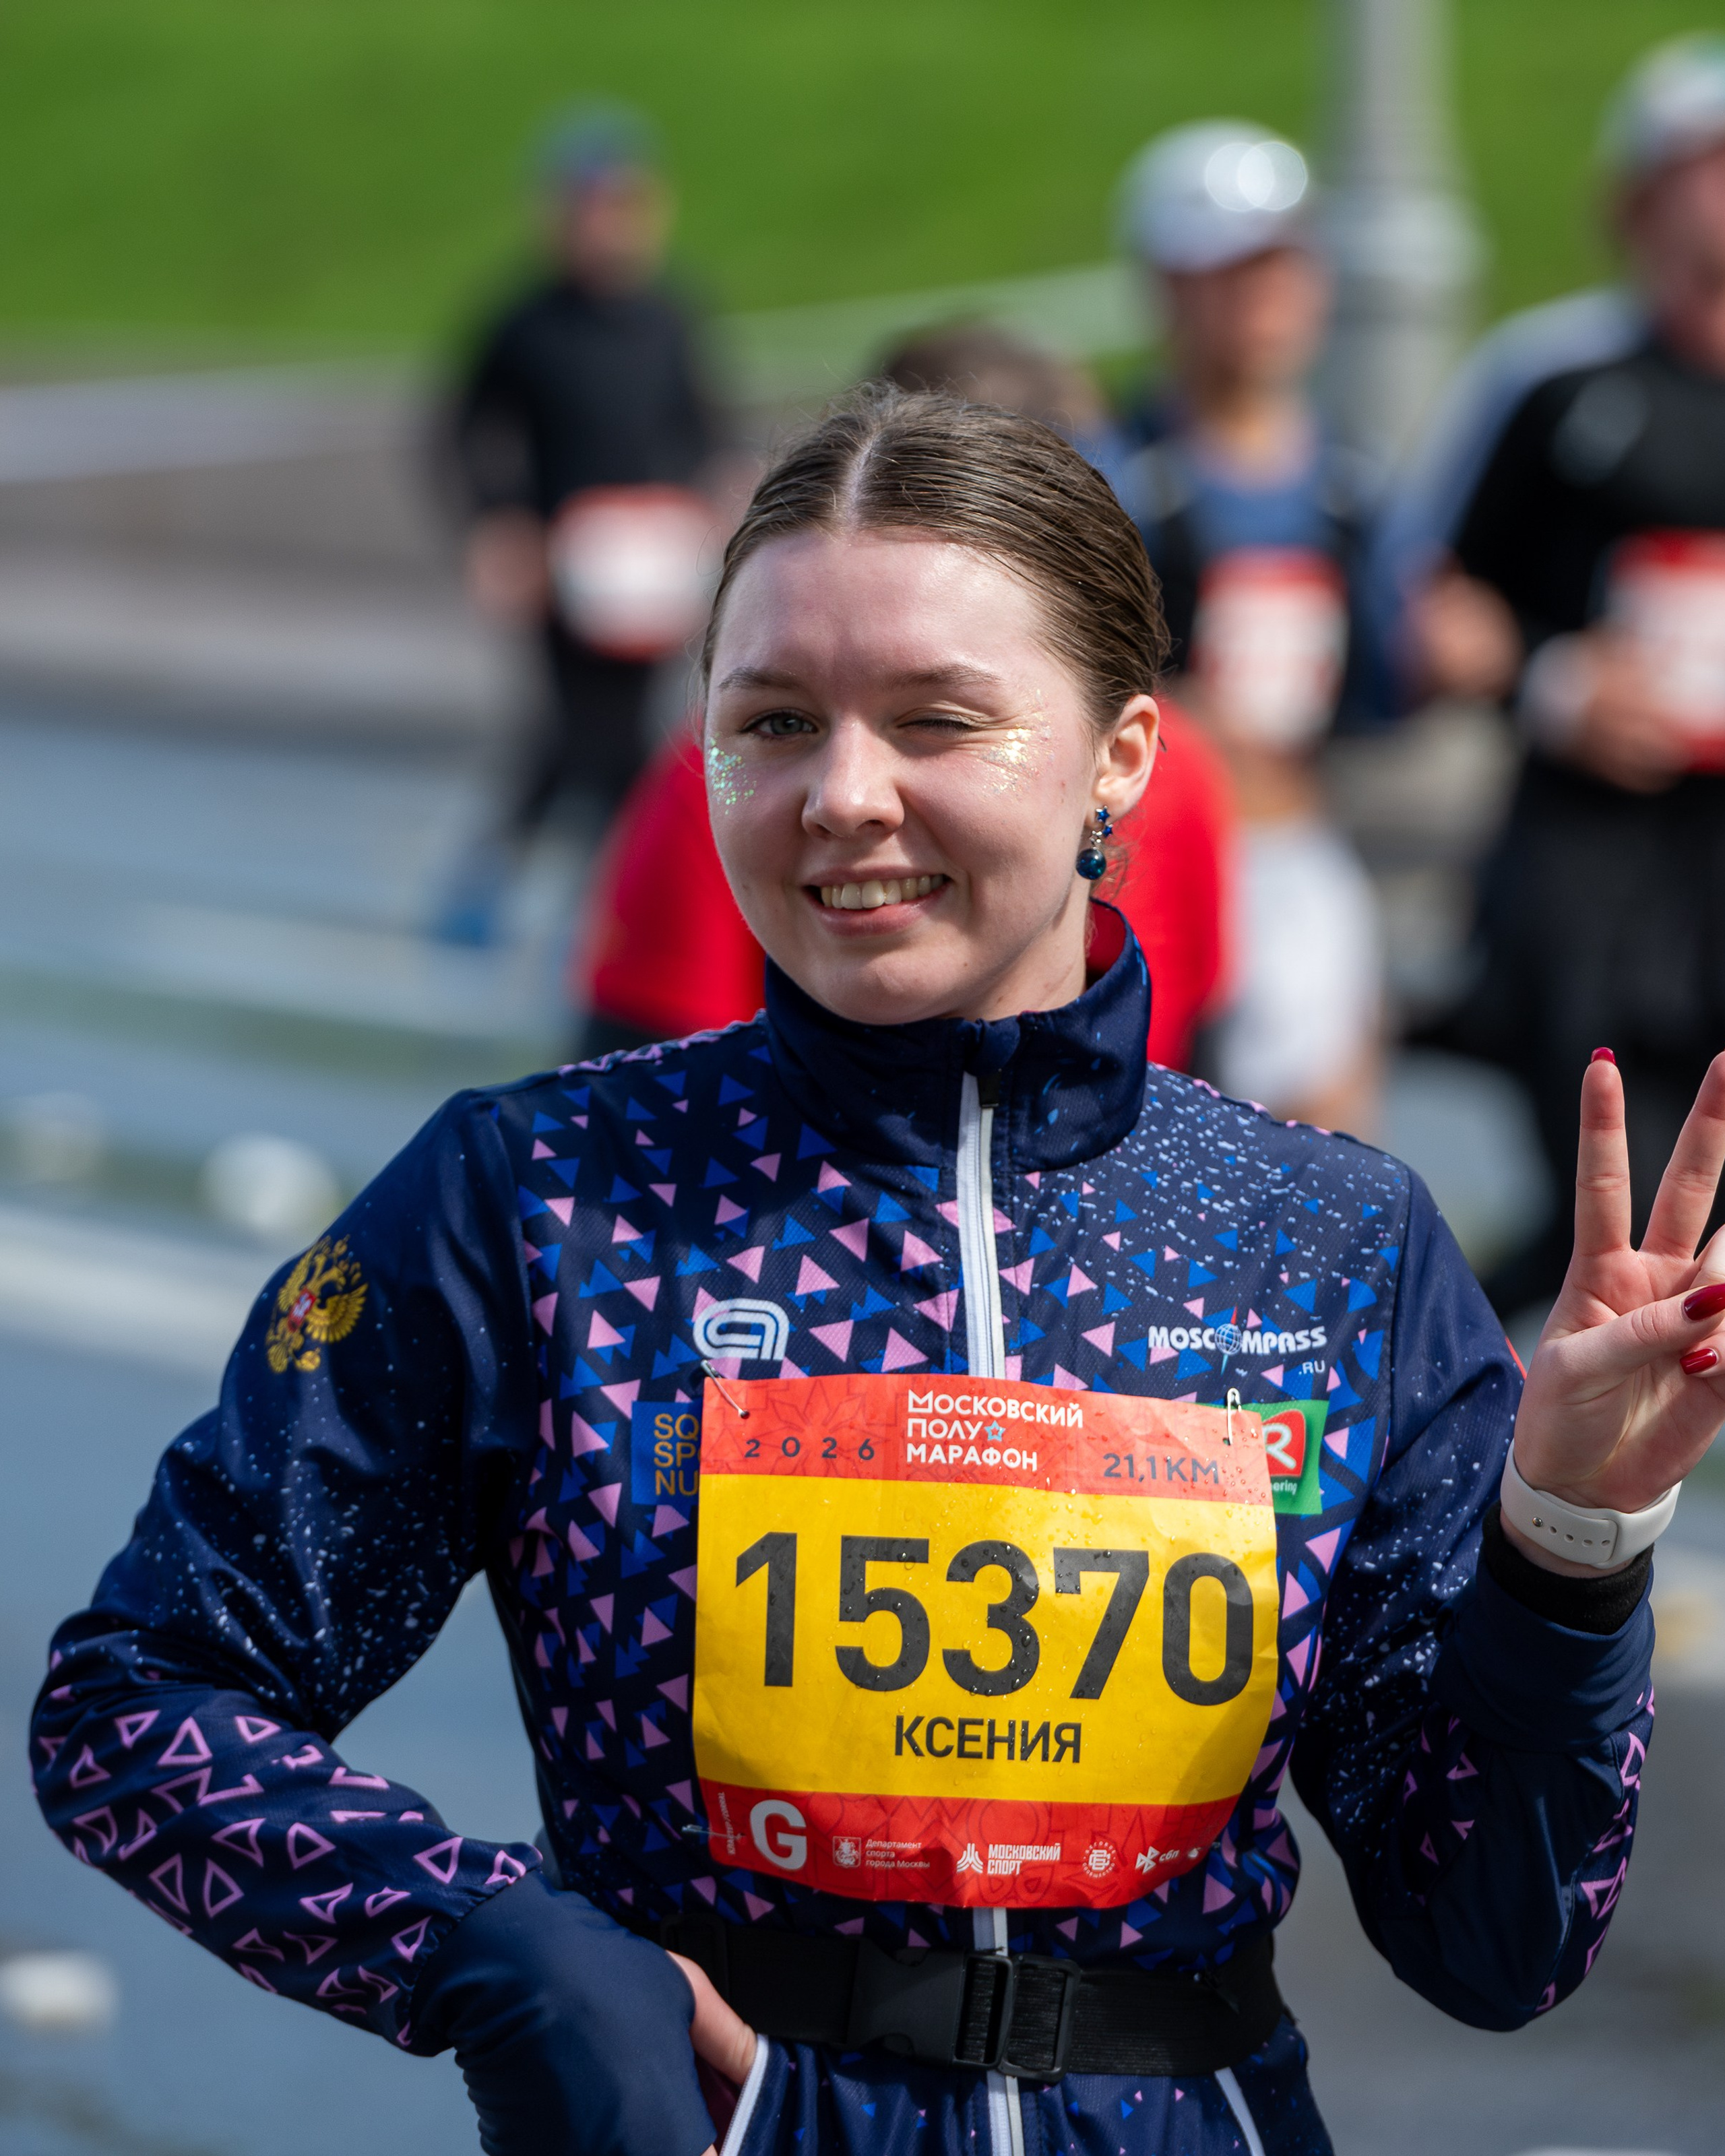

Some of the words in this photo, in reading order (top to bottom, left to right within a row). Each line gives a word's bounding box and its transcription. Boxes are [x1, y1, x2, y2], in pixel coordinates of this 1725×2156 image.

[1298, 1360, 1326, 1375] .RU
[908, 1389, 1083, 1428] МОСКОВСКИЙ
[907, 1418, 983, 1440] ПОЛУ
[906, 1442, 1038, 1471] МАРАФОН
[735, 1531, 1255, 1706] 15370
[895, 1715, 1082, 1763] КСЕНИЯ
[749, 1799, 807, 1871] G
[865, 1839, 922, 1849] Департамент
[866, 1849, 896, 1859] спорта
[988, 1843, 1061, 1861] МОСКОВСКИЙ
[865, 1859, 896, 1868] города
[896, 1860, 930, 1868] Москвы
[987, 1860, 1023, 1875] СПОРТ
